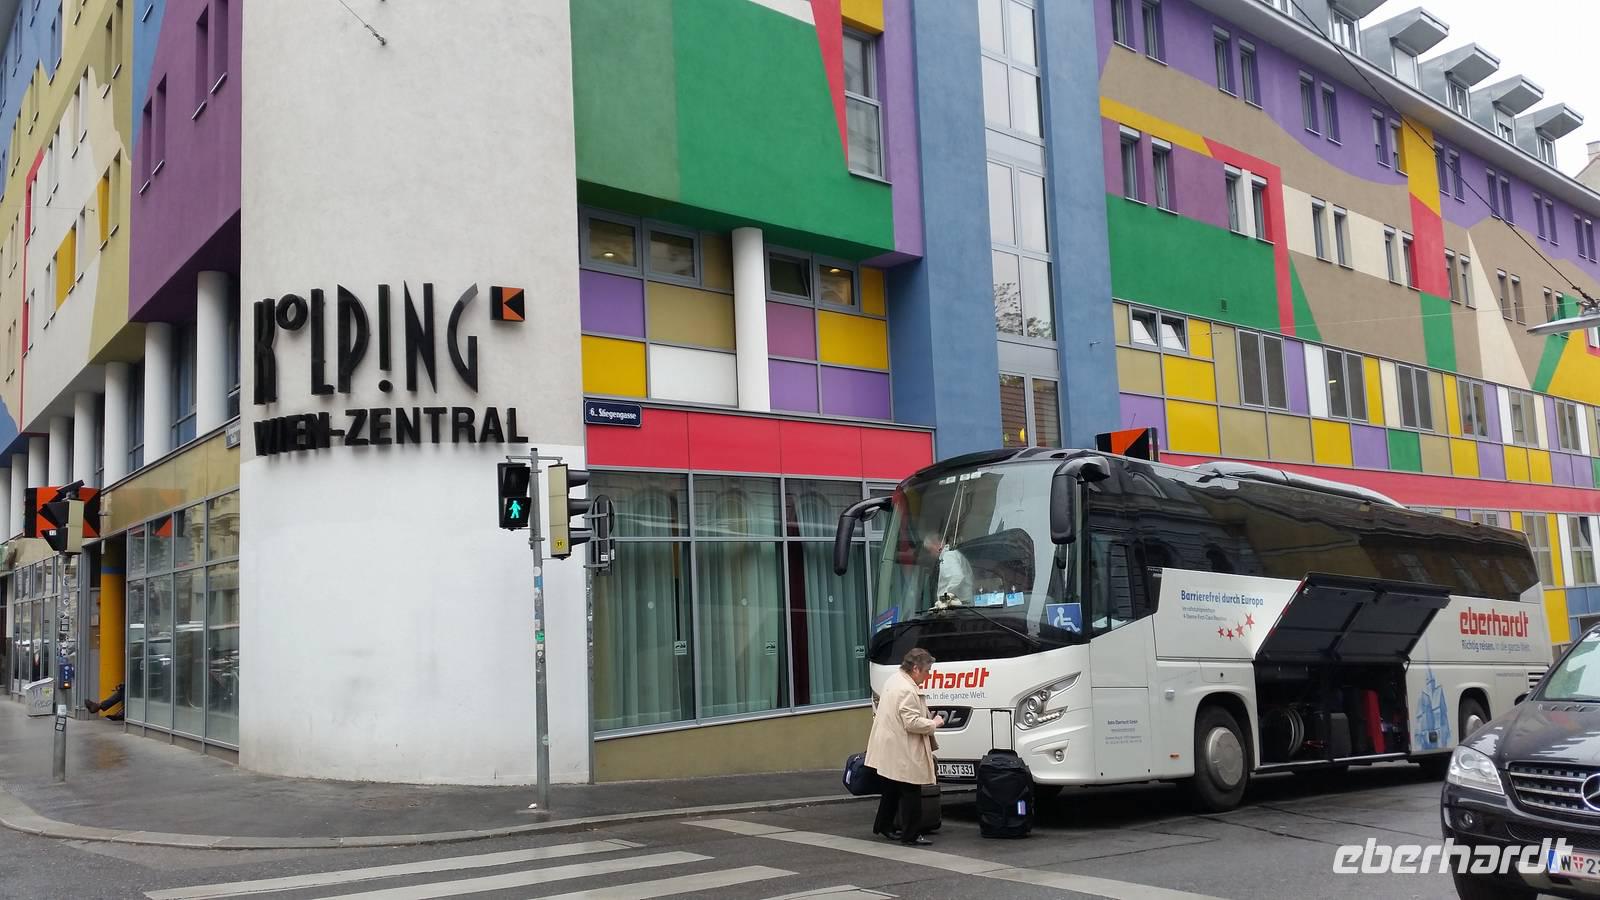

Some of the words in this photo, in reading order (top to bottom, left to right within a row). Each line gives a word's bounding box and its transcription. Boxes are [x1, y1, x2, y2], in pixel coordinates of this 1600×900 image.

[598, 408, 637, 421] Stiegengasse
[254, 407, 529, 456] WIEN-ZENTRAL
[1181, 590, 1221, 603] Barrierefrei
[1222, 593, 1241, 605] durch
[1241, 595, 1264, 608] Europa
[1460, 606, 1529, 637] eberhardt
[919, 667, 990, 690] rhardt
[932, 692, 939, 700] In
[940, 692, 949, 700] die
[950, 693, 969, 702] ganze
[1560, 855, 1572, 872] W
